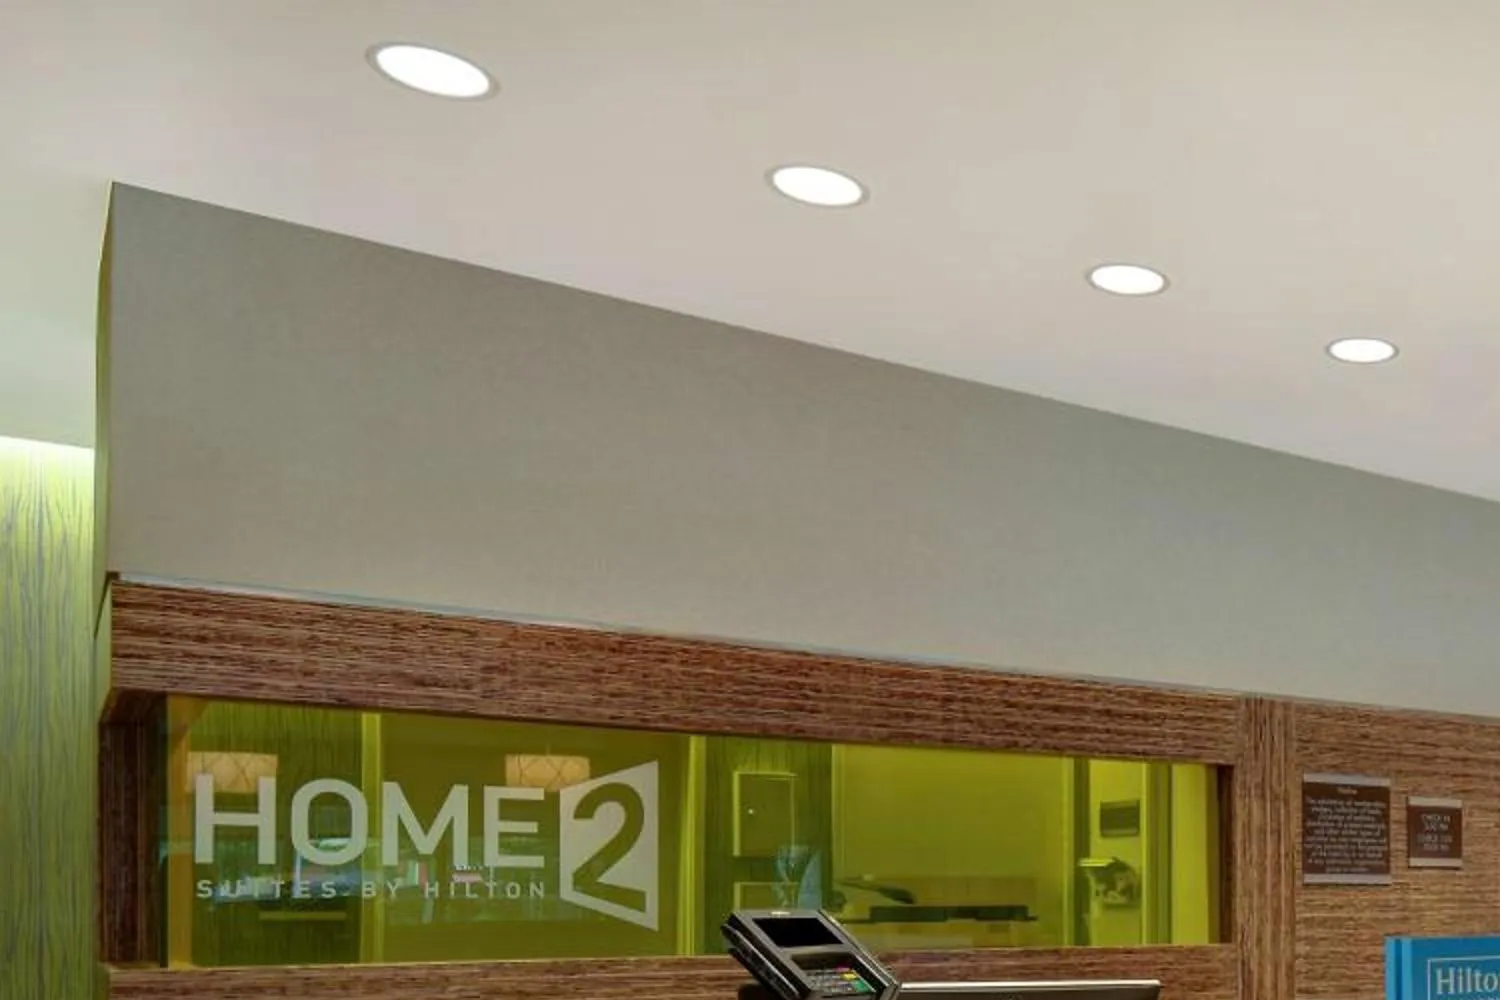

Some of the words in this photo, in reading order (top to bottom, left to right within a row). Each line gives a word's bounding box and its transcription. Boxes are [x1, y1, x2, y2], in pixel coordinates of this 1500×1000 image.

[194, 773, 546, 868] HOME
[196, 879, 337, 899] SUITES
[363, 880, 403, 899] BY
[424, 880, 546, 899] HILTON
